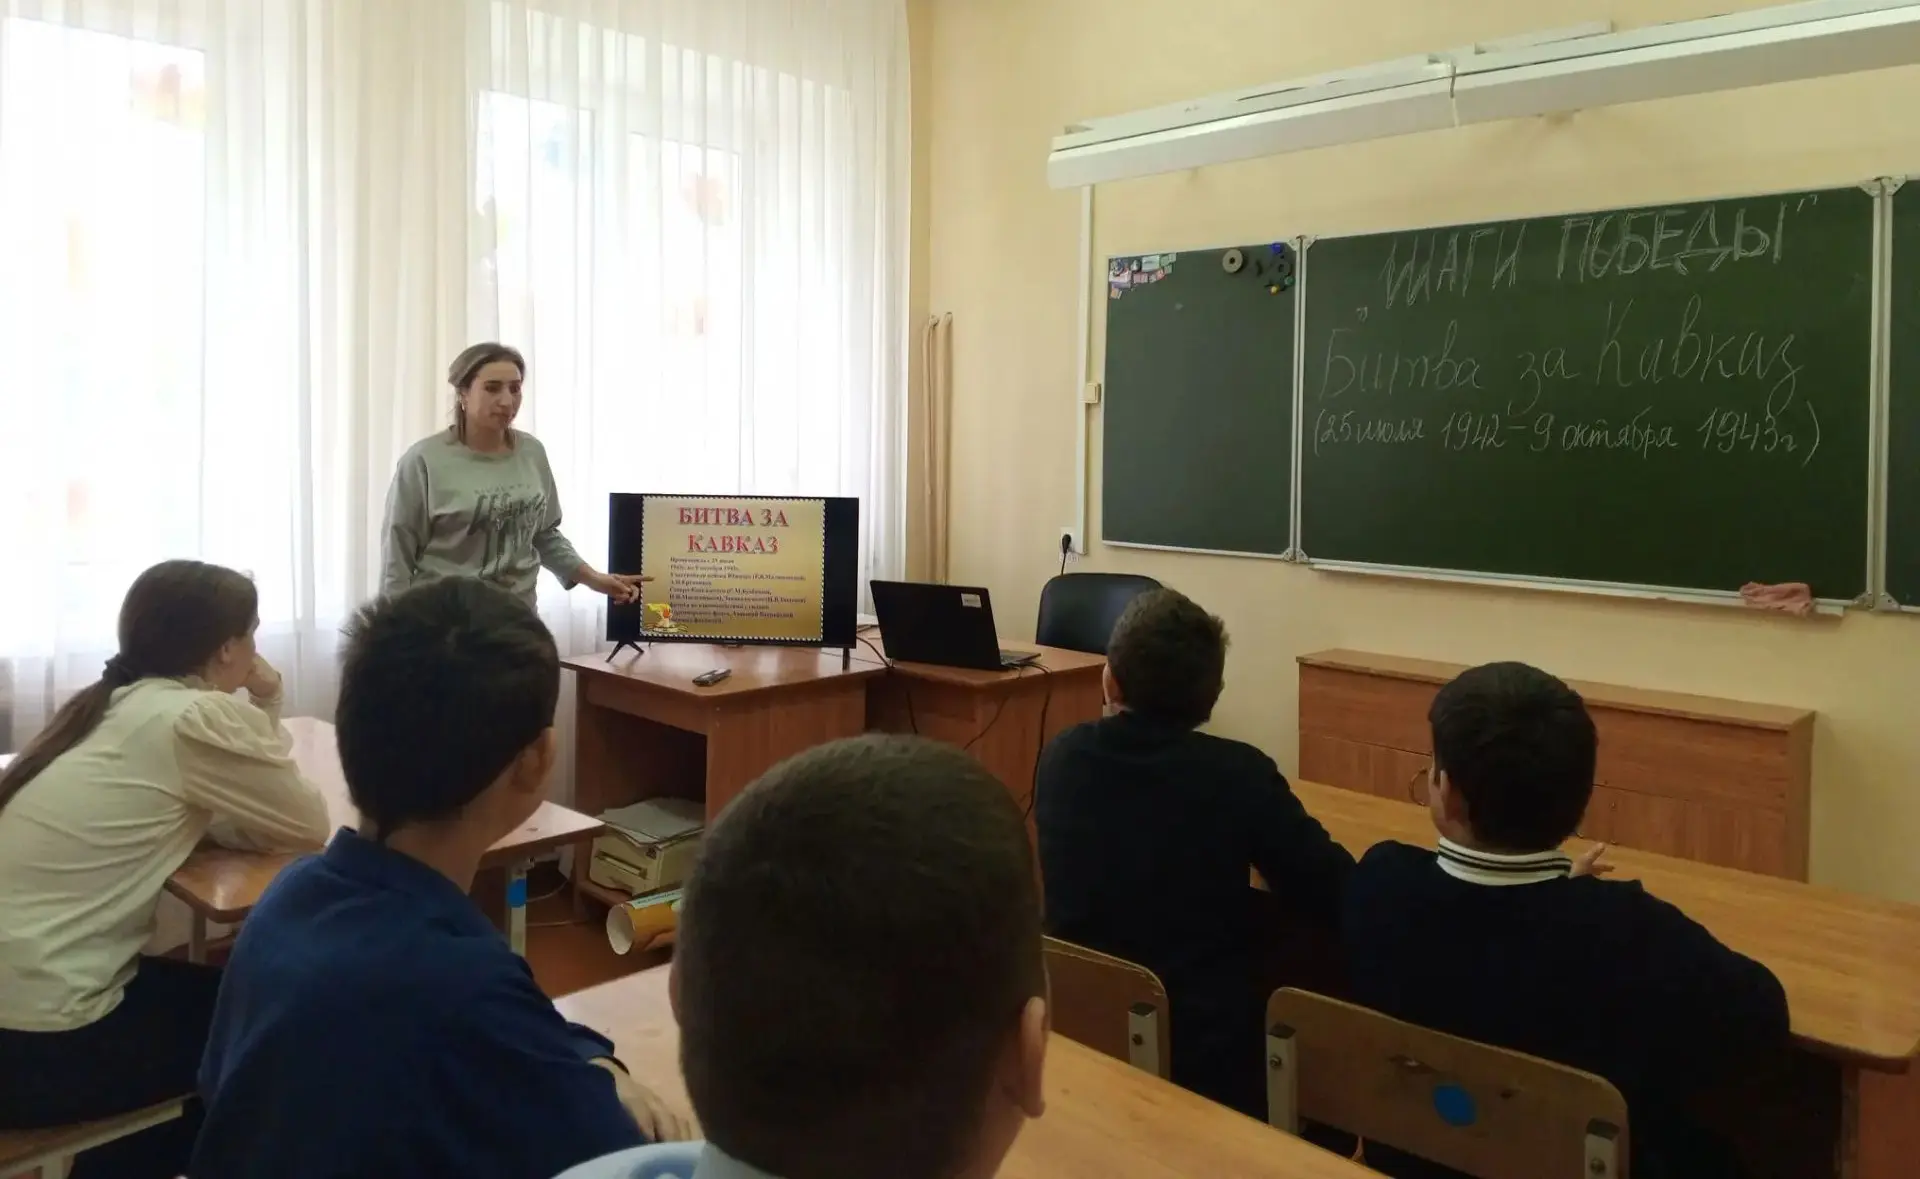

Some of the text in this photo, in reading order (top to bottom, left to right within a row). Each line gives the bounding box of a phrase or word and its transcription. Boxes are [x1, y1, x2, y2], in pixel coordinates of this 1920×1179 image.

[1320, 294, 1804, 416] Битва за Кавказ
[1562, 405, 1678, 459] октября
[678, 507, 789, 527] БИТВА ЗА
[688, 534, 780, 554] КАВКАЗ
